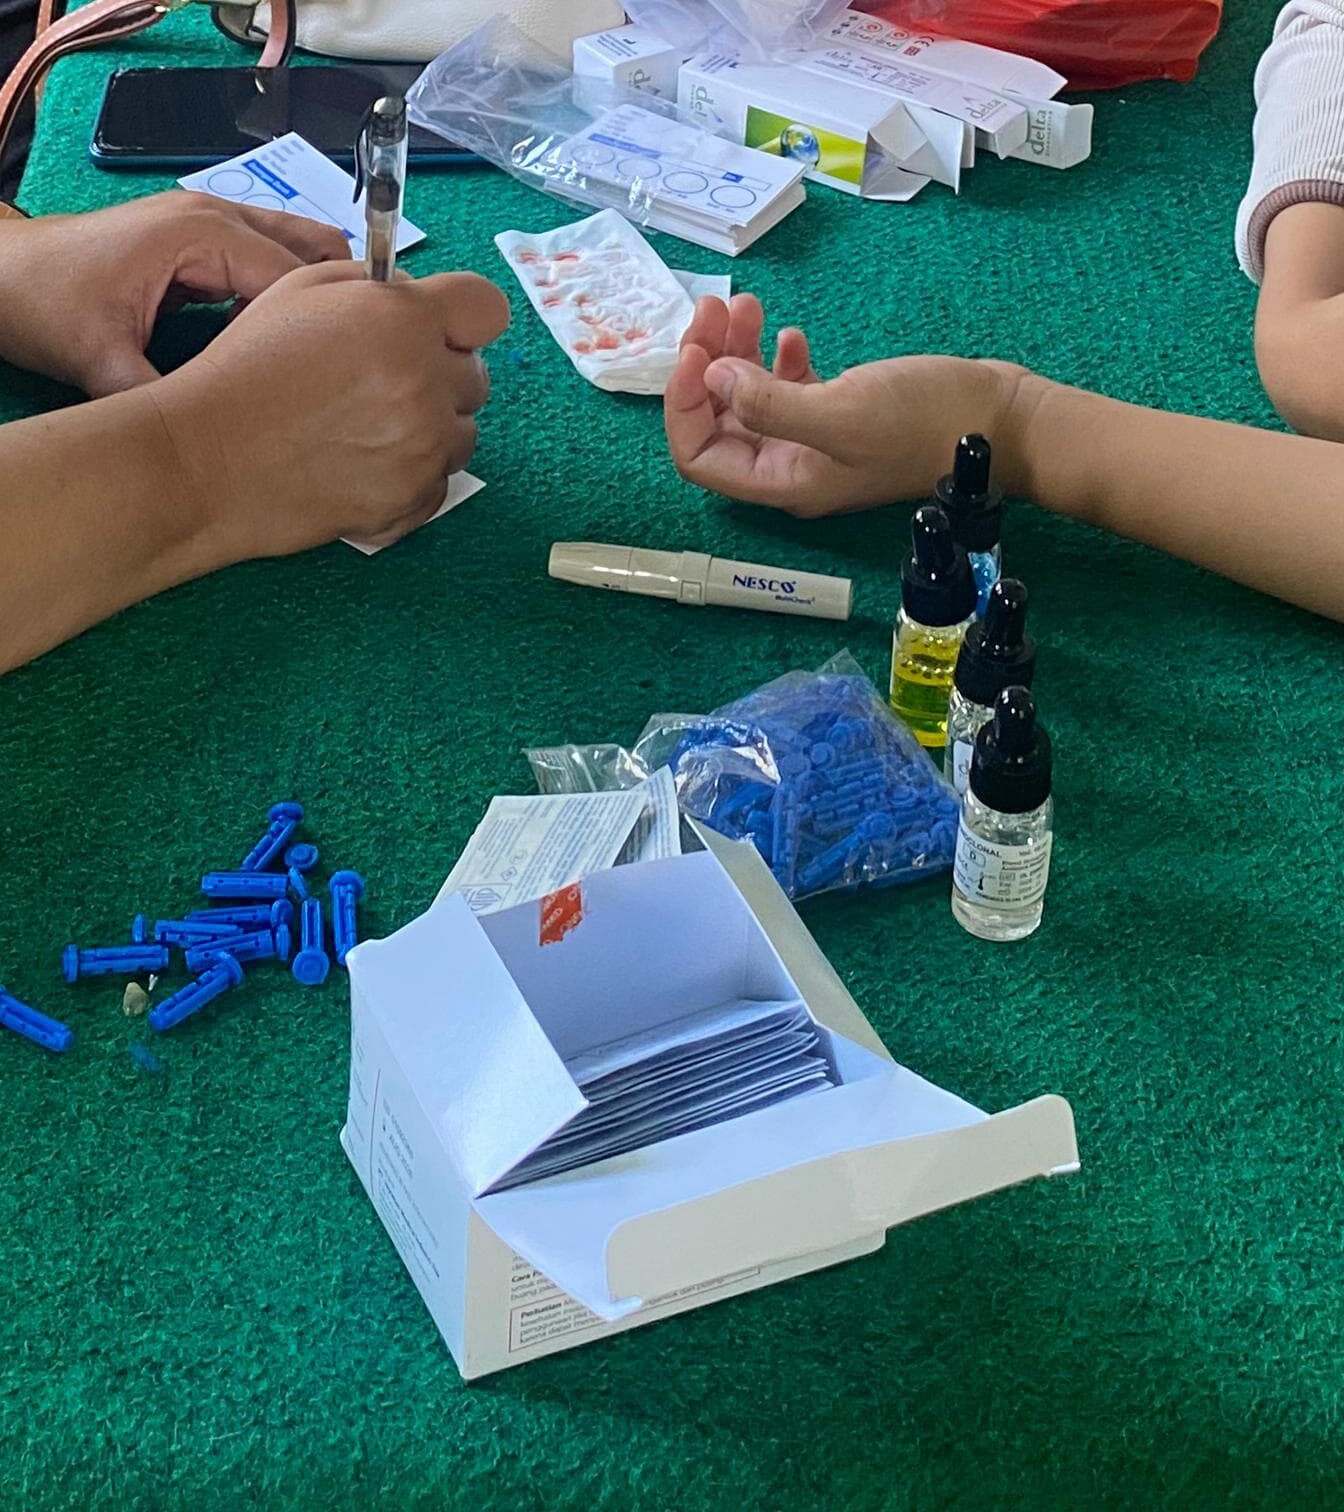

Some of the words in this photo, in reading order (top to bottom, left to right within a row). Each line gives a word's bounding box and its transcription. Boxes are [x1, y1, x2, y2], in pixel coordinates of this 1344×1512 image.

[965, 99, 1001, 119] delta
[1031, 110, 1047, 155] delta
[733, 574, 795, 594] NESCO
